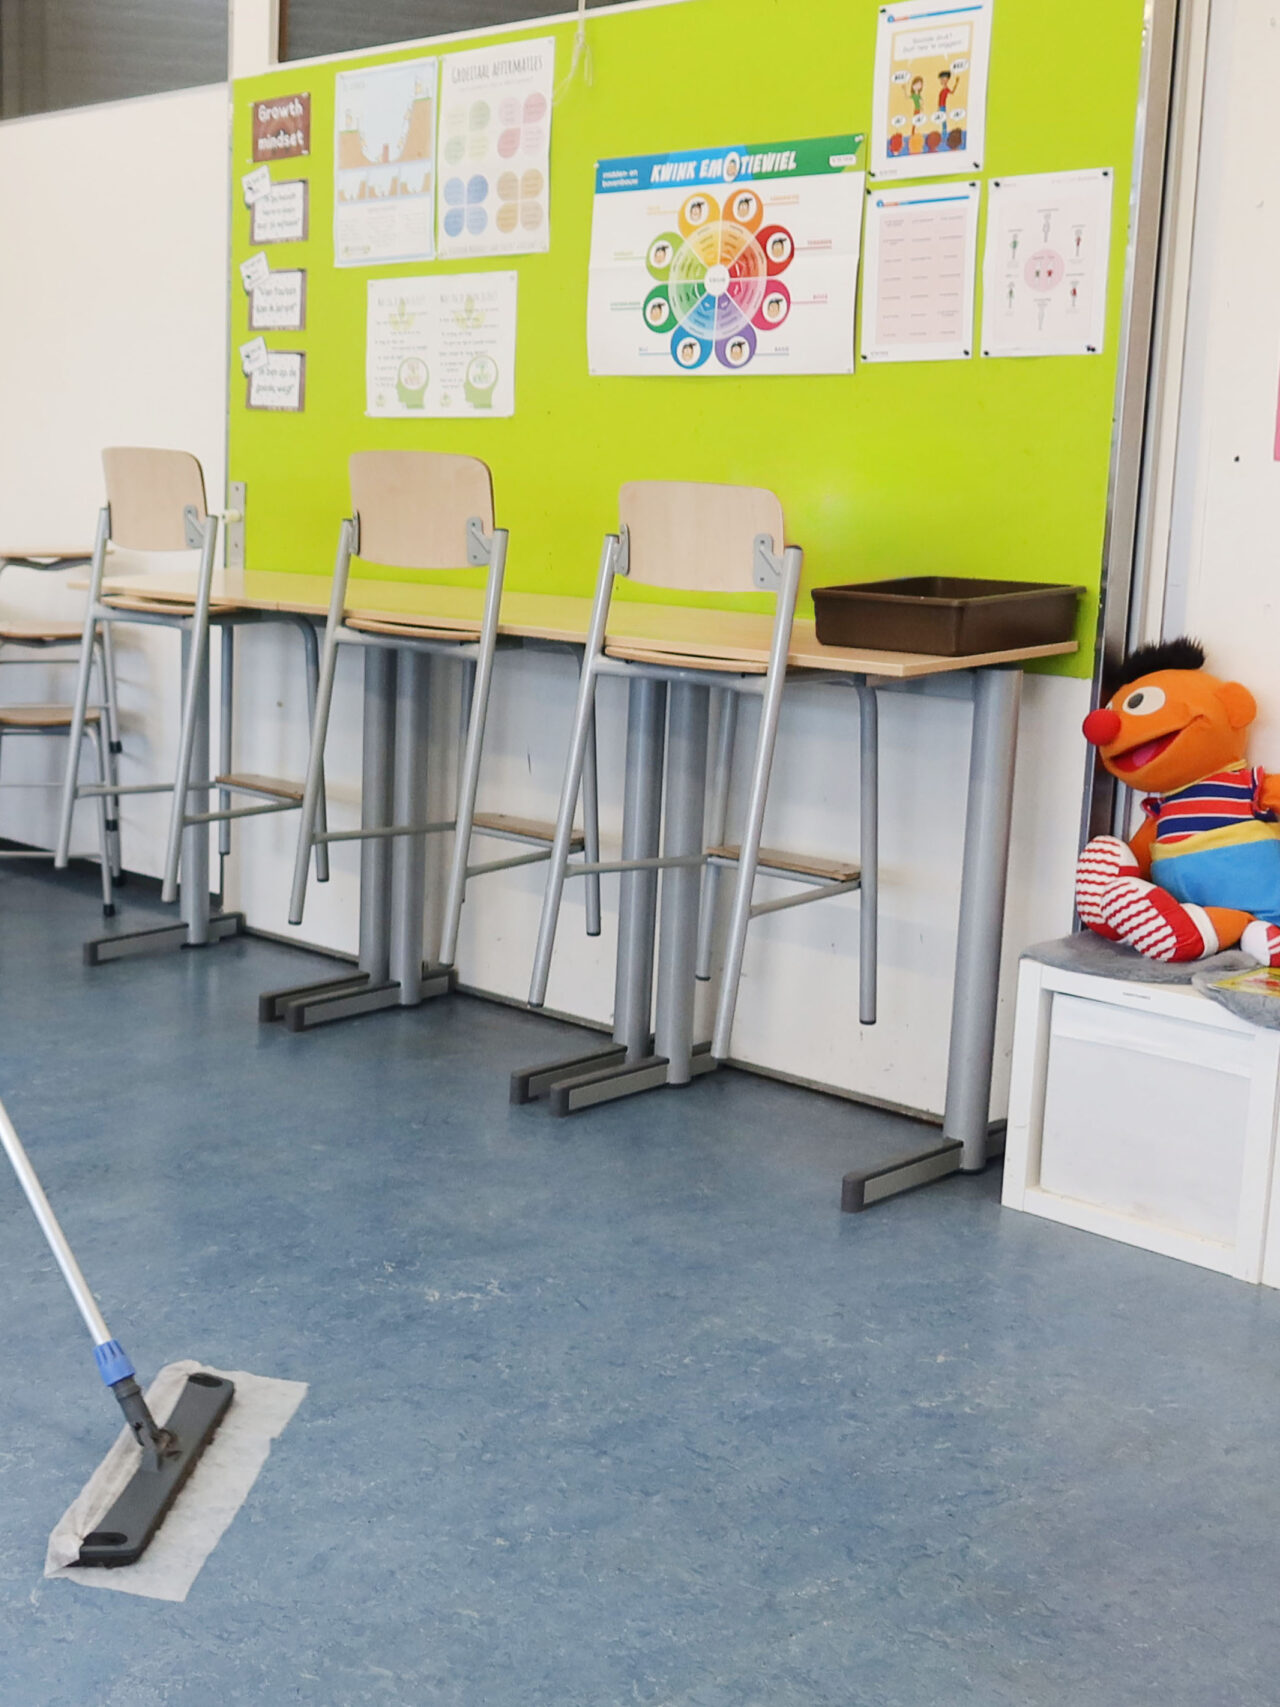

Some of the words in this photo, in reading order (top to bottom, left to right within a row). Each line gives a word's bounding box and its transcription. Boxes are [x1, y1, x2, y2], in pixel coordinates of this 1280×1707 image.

[258, 97, 304, 123] Growth
[257, 129, 305, 150] mindset
[650, 160, 698, 183] KWINK
